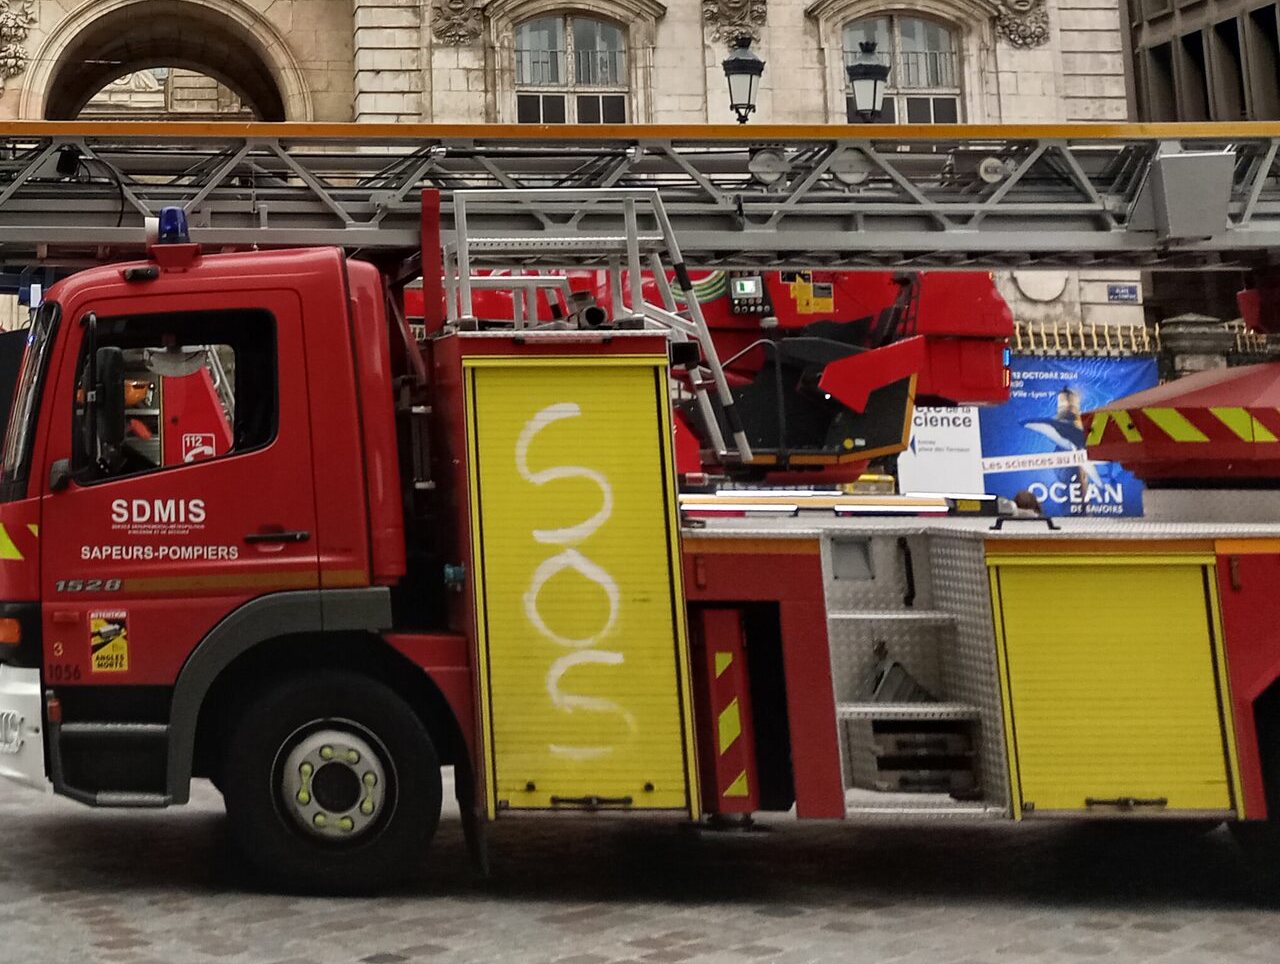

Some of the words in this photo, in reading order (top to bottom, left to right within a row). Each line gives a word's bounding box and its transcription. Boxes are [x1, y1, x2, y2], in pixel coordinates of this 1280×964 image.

[1022, 371, 1059, 379] OCTOBRE
[914, 412, 972, 427] cience
[184, 436, 202, 447] 112
[1004, 456, 1055, 469] sciences
[1057, 455, 1071, 465] au
[1028, 474, 1124, 504] OCÉAN
[111, 498, 206, 523] SDMIS
[81, 545, 239, 560] SAPEURS-POMPIERS
[56, 578, 122, 592] 1528
[95, 653, 125, 661] ANGLES
[48, 664, 81, 681] 1056
